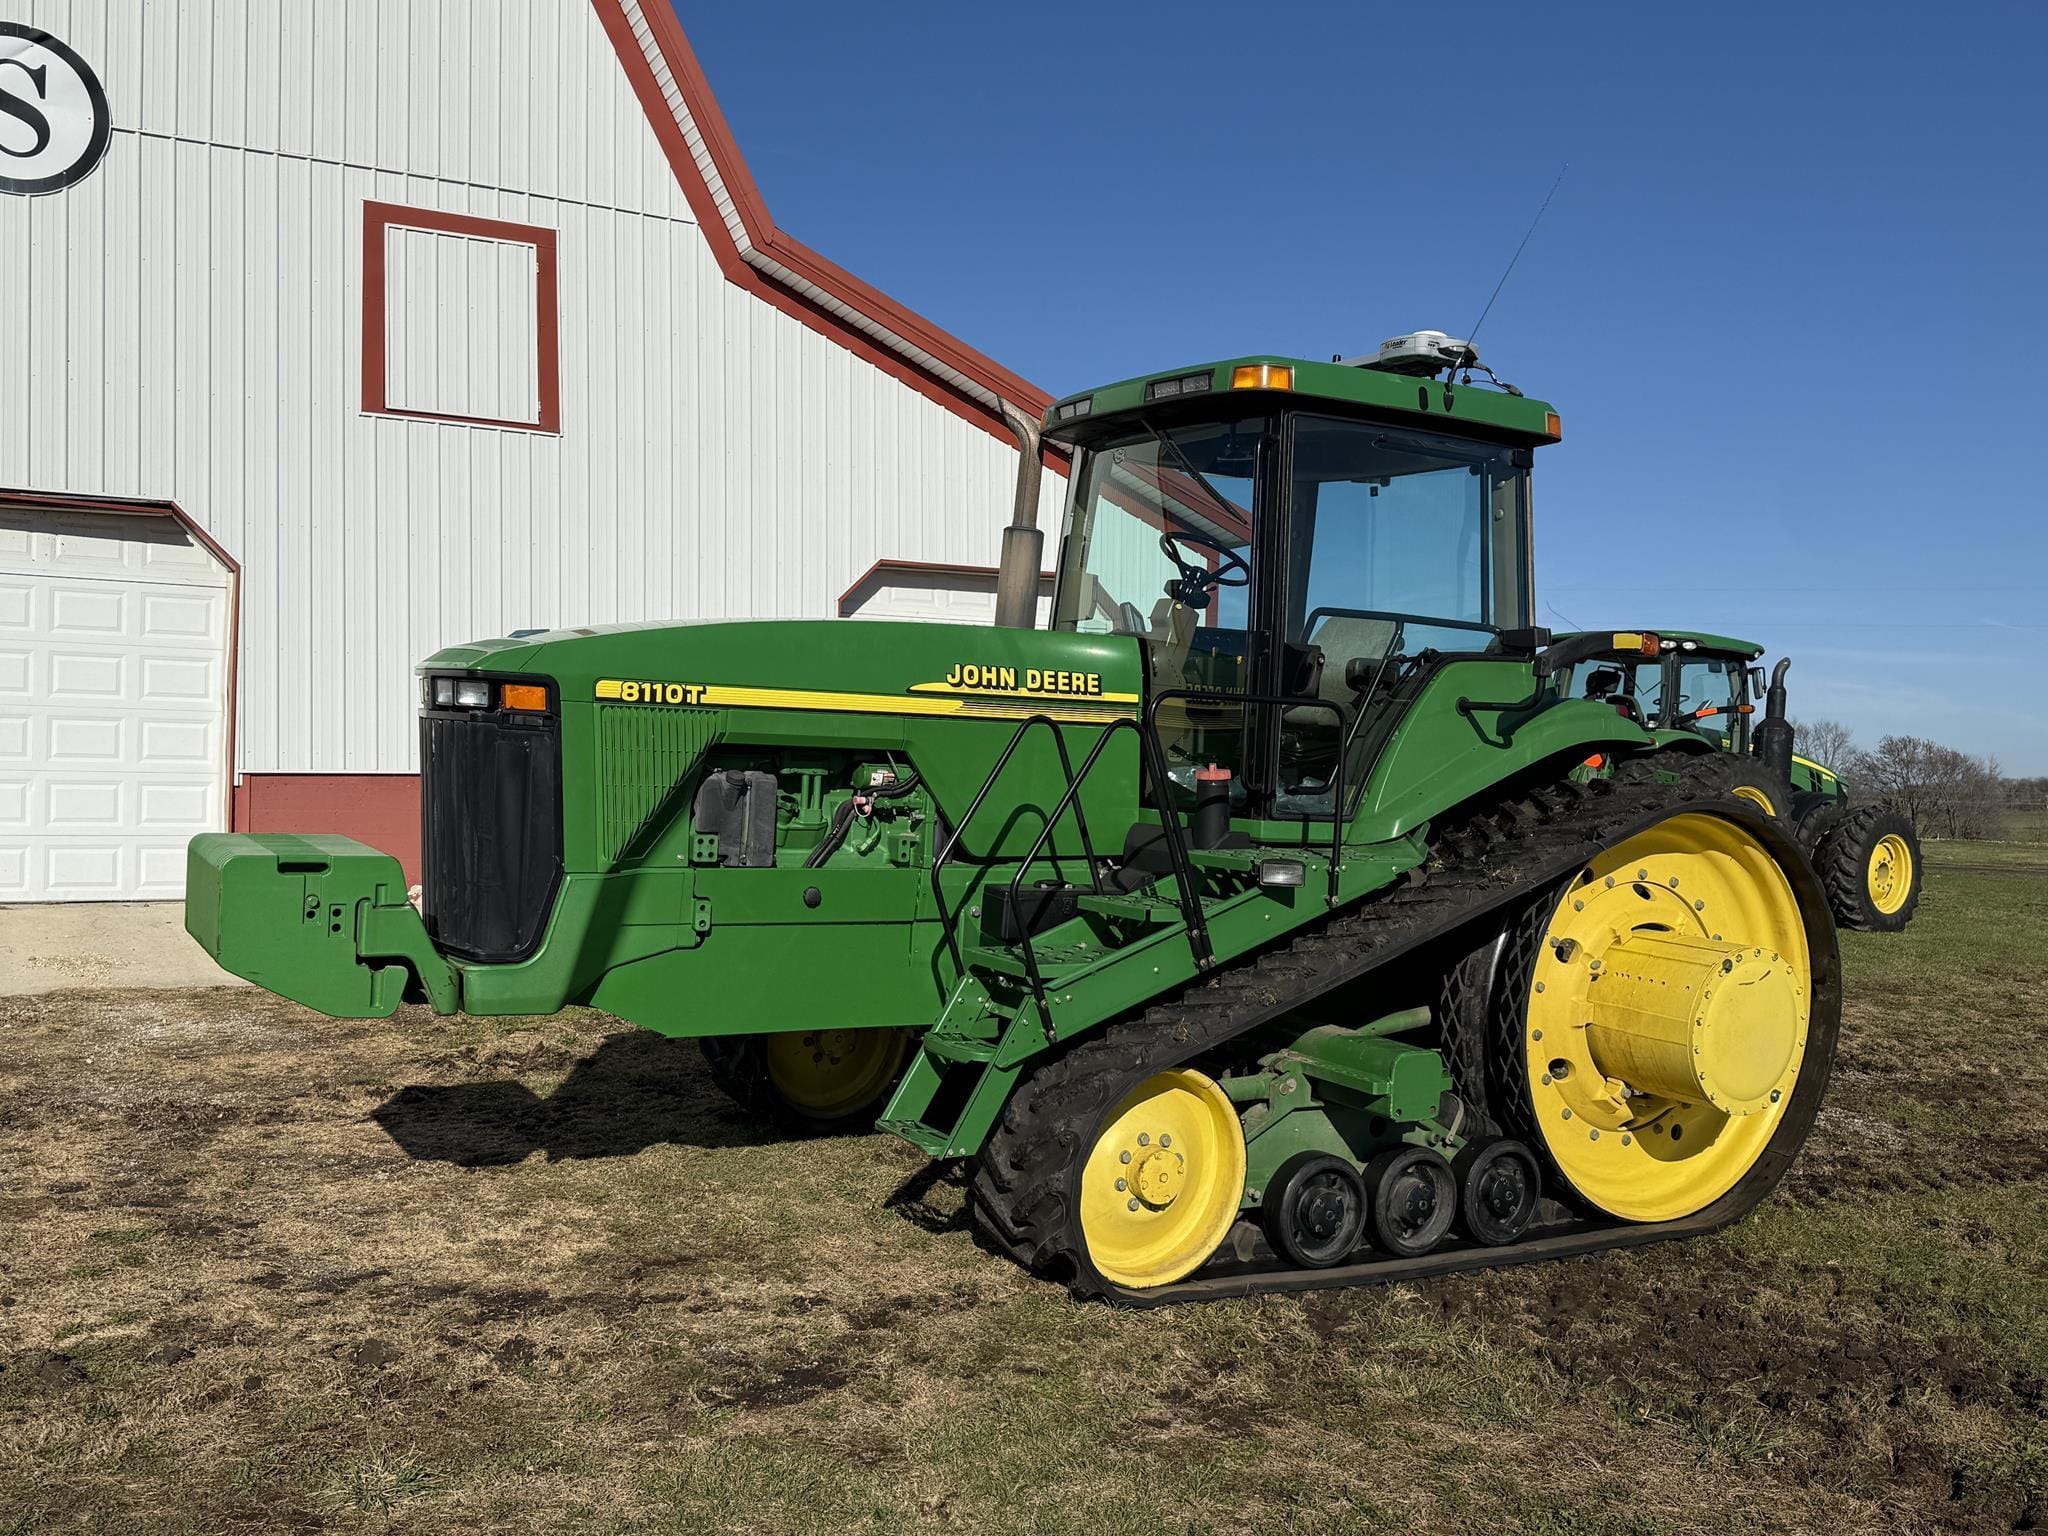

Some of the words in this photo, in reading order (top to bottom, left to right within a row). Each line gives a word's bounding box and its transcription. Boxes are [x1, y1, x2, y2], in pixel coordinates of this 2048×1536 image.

[0, 58, 51, 158] S
[621, 681, 704, 705] 8110T
[946, 663, 1017, 689] JOHN
[1026, 669, 1101, 694] DEERE
